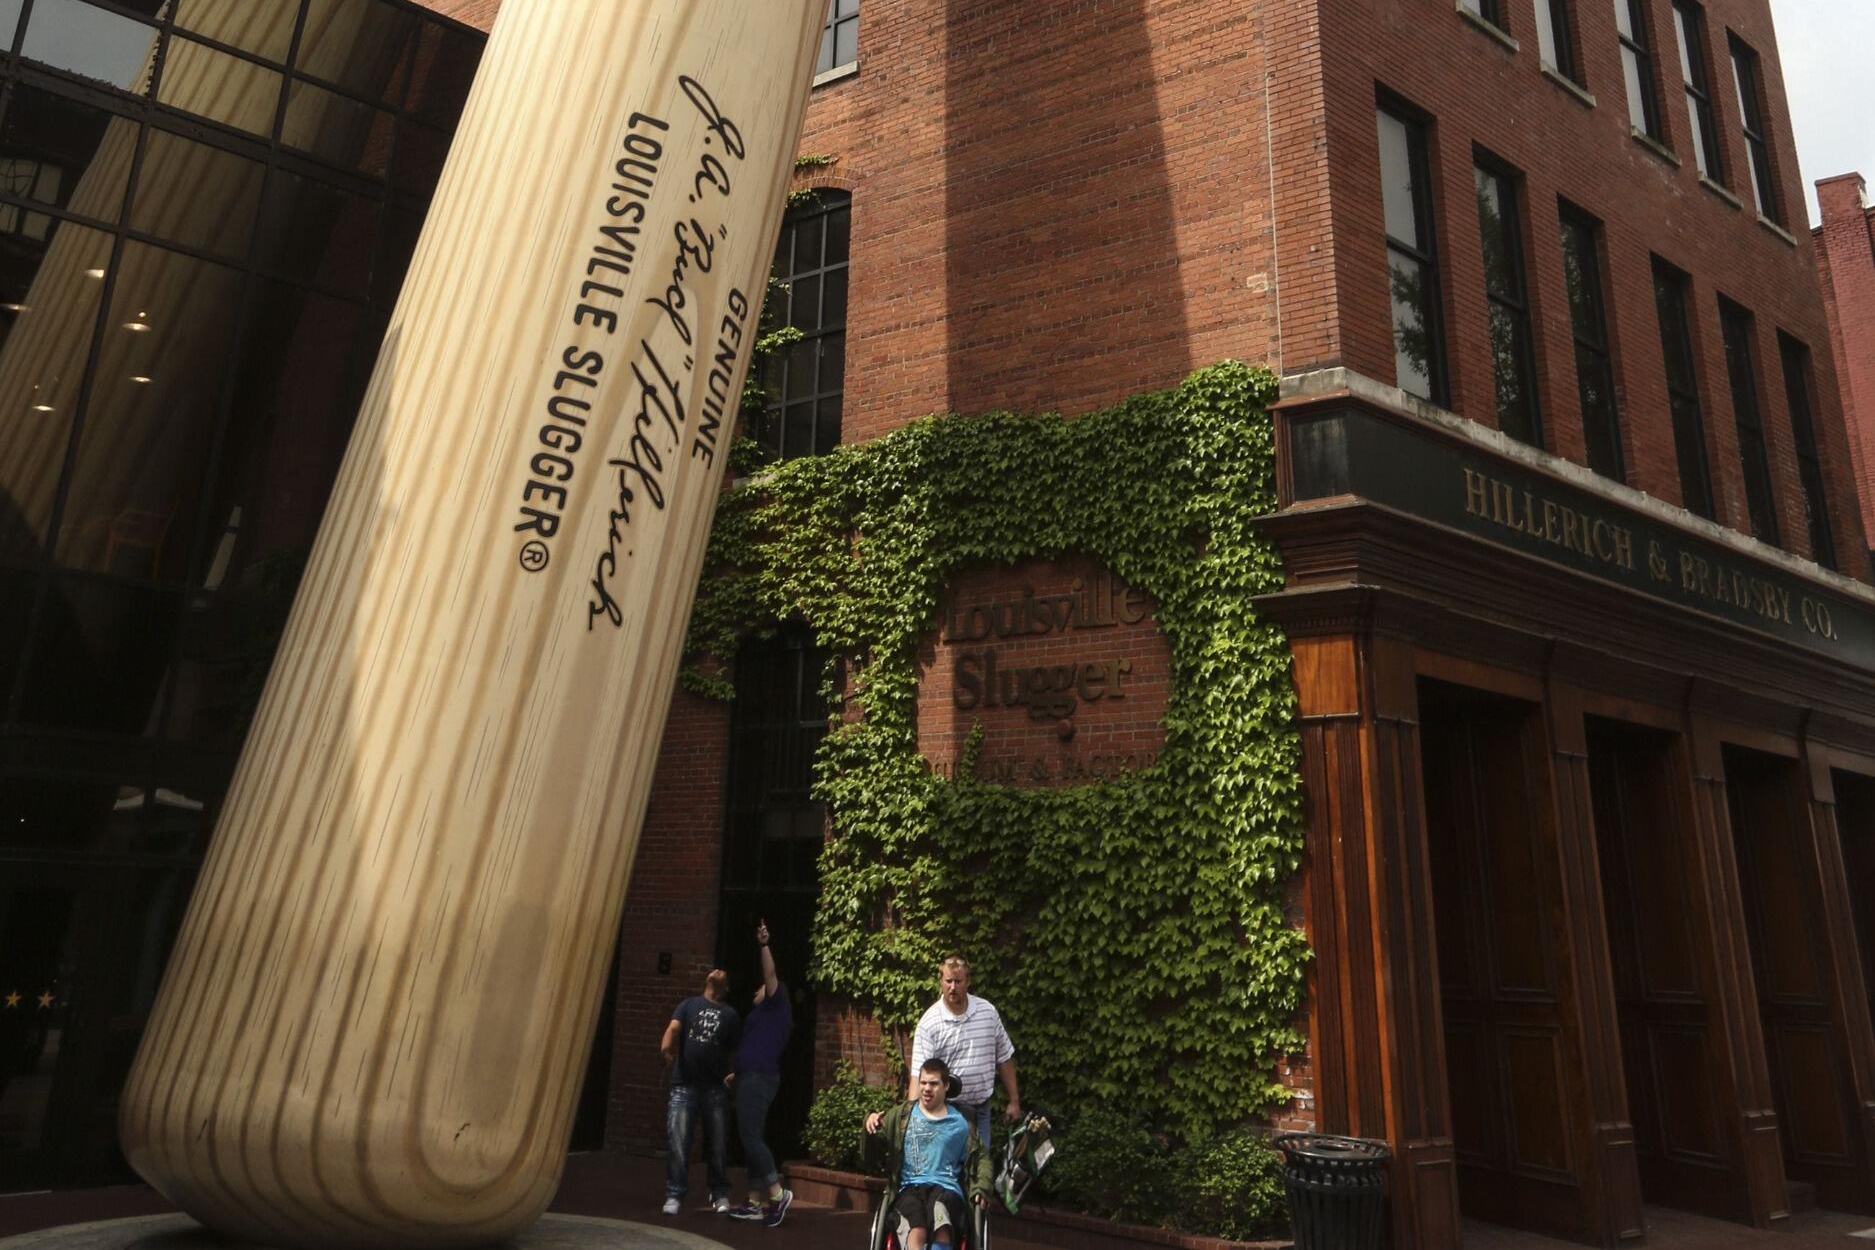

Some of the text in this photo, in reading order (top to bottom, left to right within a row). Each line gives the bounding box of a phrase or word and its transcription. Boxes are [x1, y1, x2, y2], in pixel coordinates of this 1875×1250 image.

[573, 111, 669, 335] LOUISVILLE
[691, 287, 748, 471] GENUINE
[587, 338, 685, 632] Hillerich
[1463, 467, 1838, 642] HILLERICH & BRADSBY CO.
[943, 570, 1147, 645] Louisville
[954, 650, 1133, 720] Slugger
